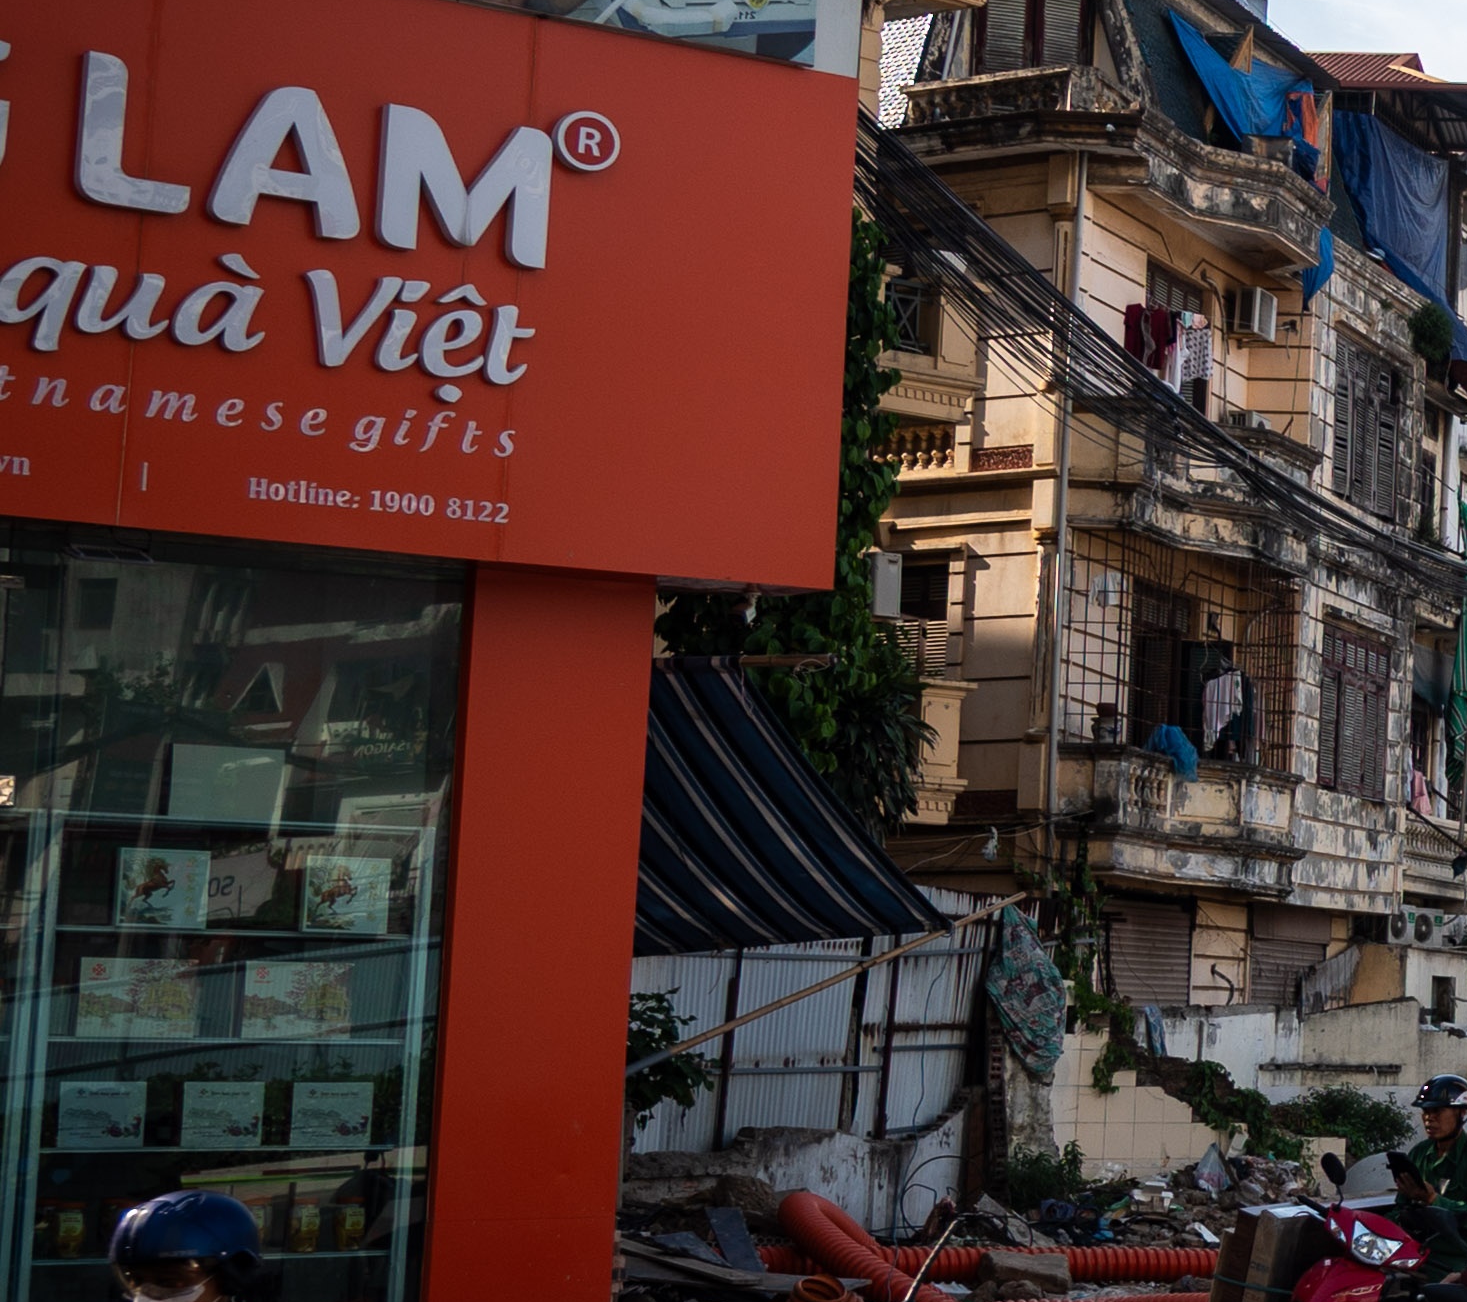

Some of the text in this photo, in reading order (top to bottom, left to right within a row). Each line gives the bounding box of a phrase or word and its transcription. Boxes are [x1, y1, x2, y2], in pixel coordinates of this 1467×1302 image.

[74, 49, 554, 270] LAM
[0, 253, 537, 404] quà Việt
[349, 410, 517, 459] gifts
[249, 476, 510, 525] Hotline: 1900 8122
